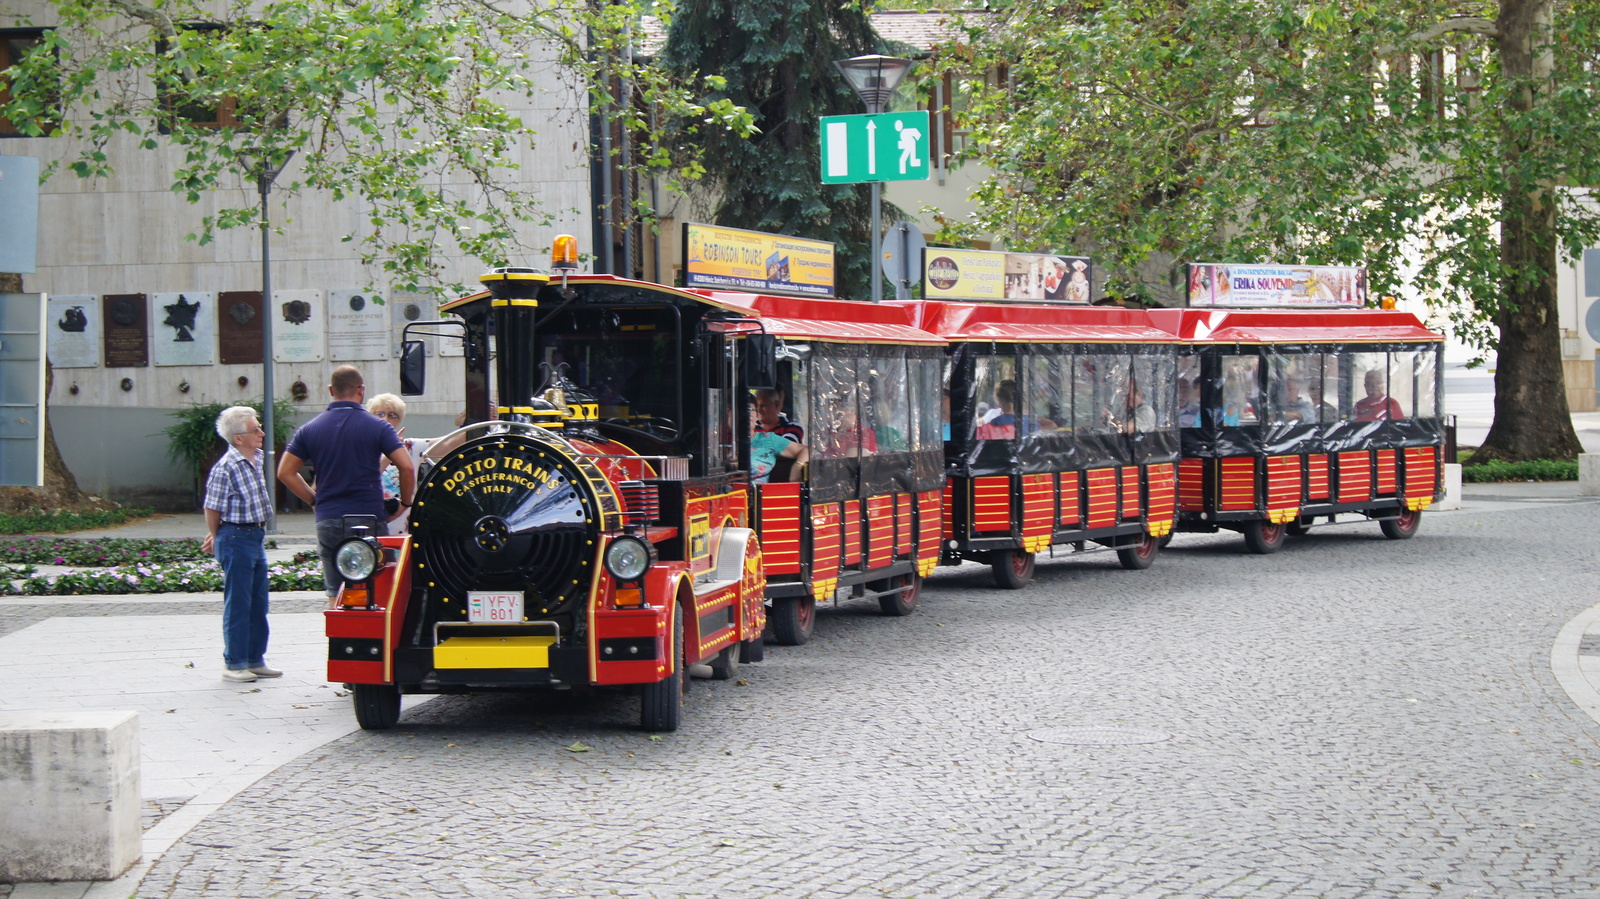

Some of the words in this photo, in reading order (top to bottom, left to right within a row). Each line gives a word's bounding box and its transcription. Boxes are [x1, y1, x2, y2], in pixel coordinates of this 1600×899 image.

[704, 242, 739, 263] ROBINSON
[741, 246, 762, 266] TOURS
[1233, 277, 1256, 290] ERIKA
[1257, 277, 1294, 291] SOUVENIR
[443, 457, 497, 492] DOTTO
[503, 456, 560, 490] TRAINS
[455, 472, 536, 497] CASTELFRANCO
[482, 485, 513, 494] ITALY
[488, 595, 516, 608] YFV
[472, 608, 481, 617] H
[491, 608, 513, 620] 801
